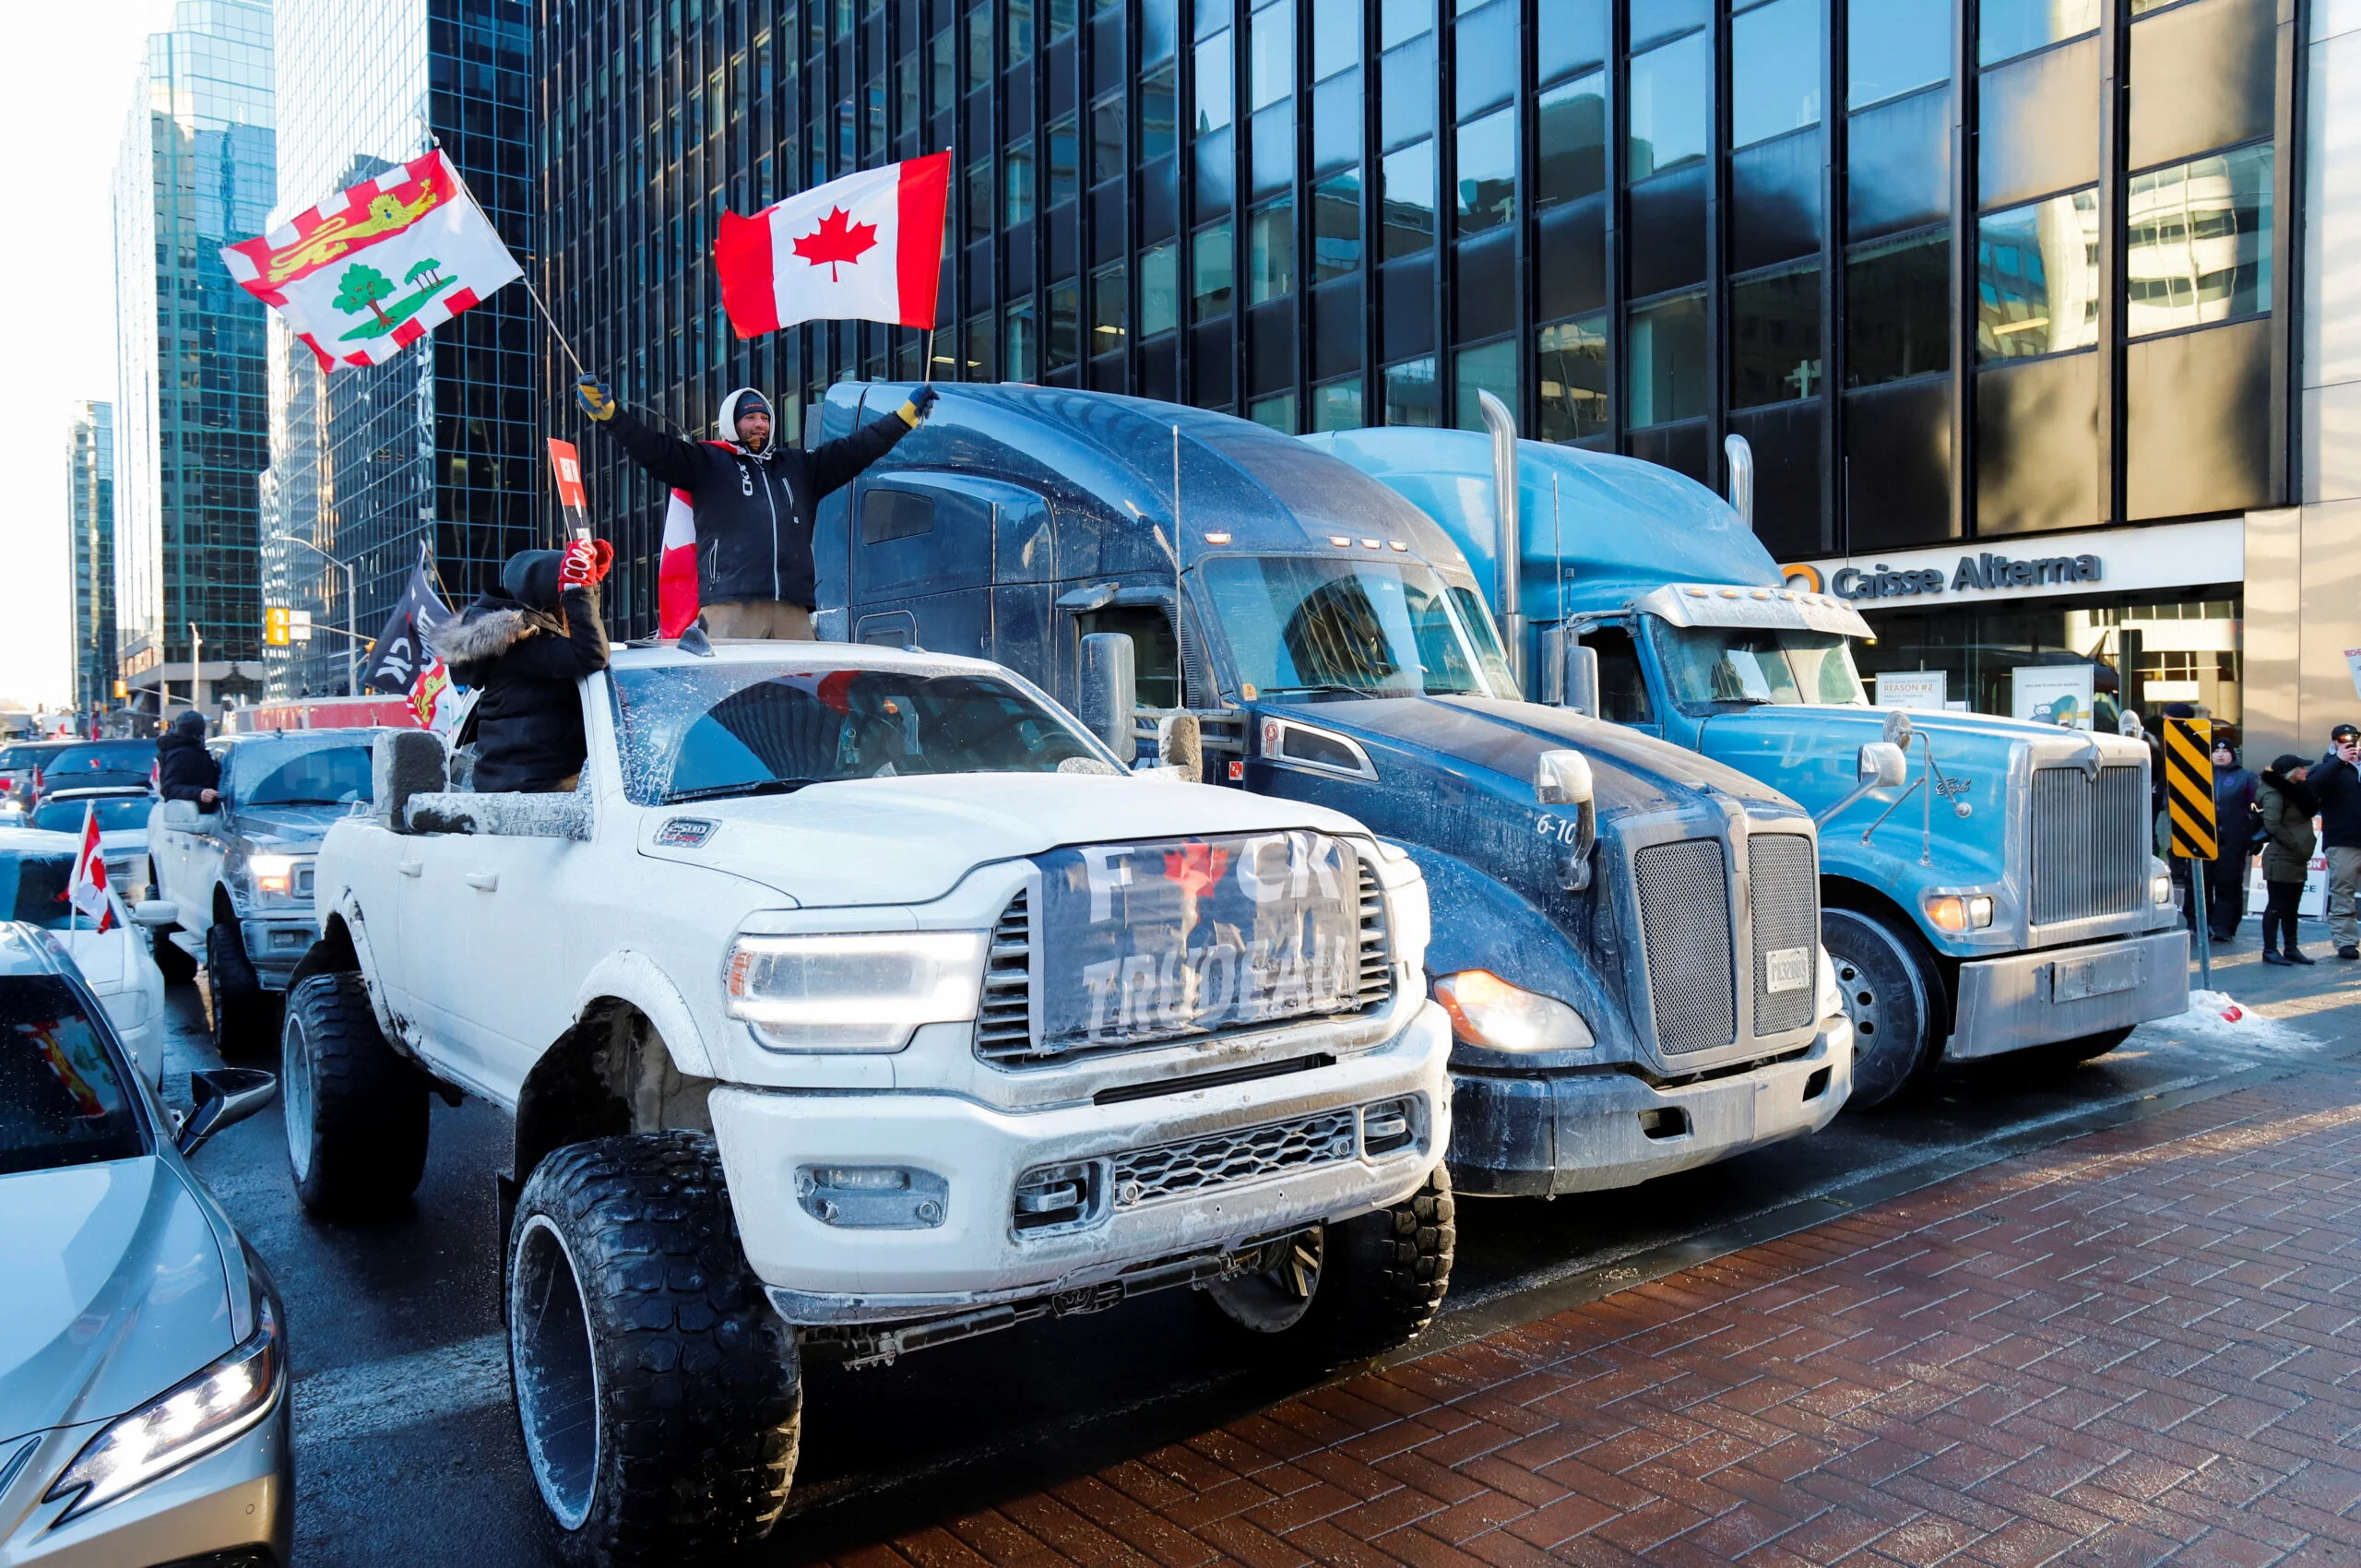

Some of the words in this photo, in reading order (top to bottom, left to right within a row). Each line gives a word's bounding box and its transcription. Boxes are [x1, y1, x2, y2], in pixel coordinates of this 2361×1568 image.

[1832, 564, 1944, 600] Caisse
[1950, 552, 2101, 590] Alterna
[1884, 683, 1918, 692] REASON
[1083, 933, 1346, 1042] TRUDEAU
